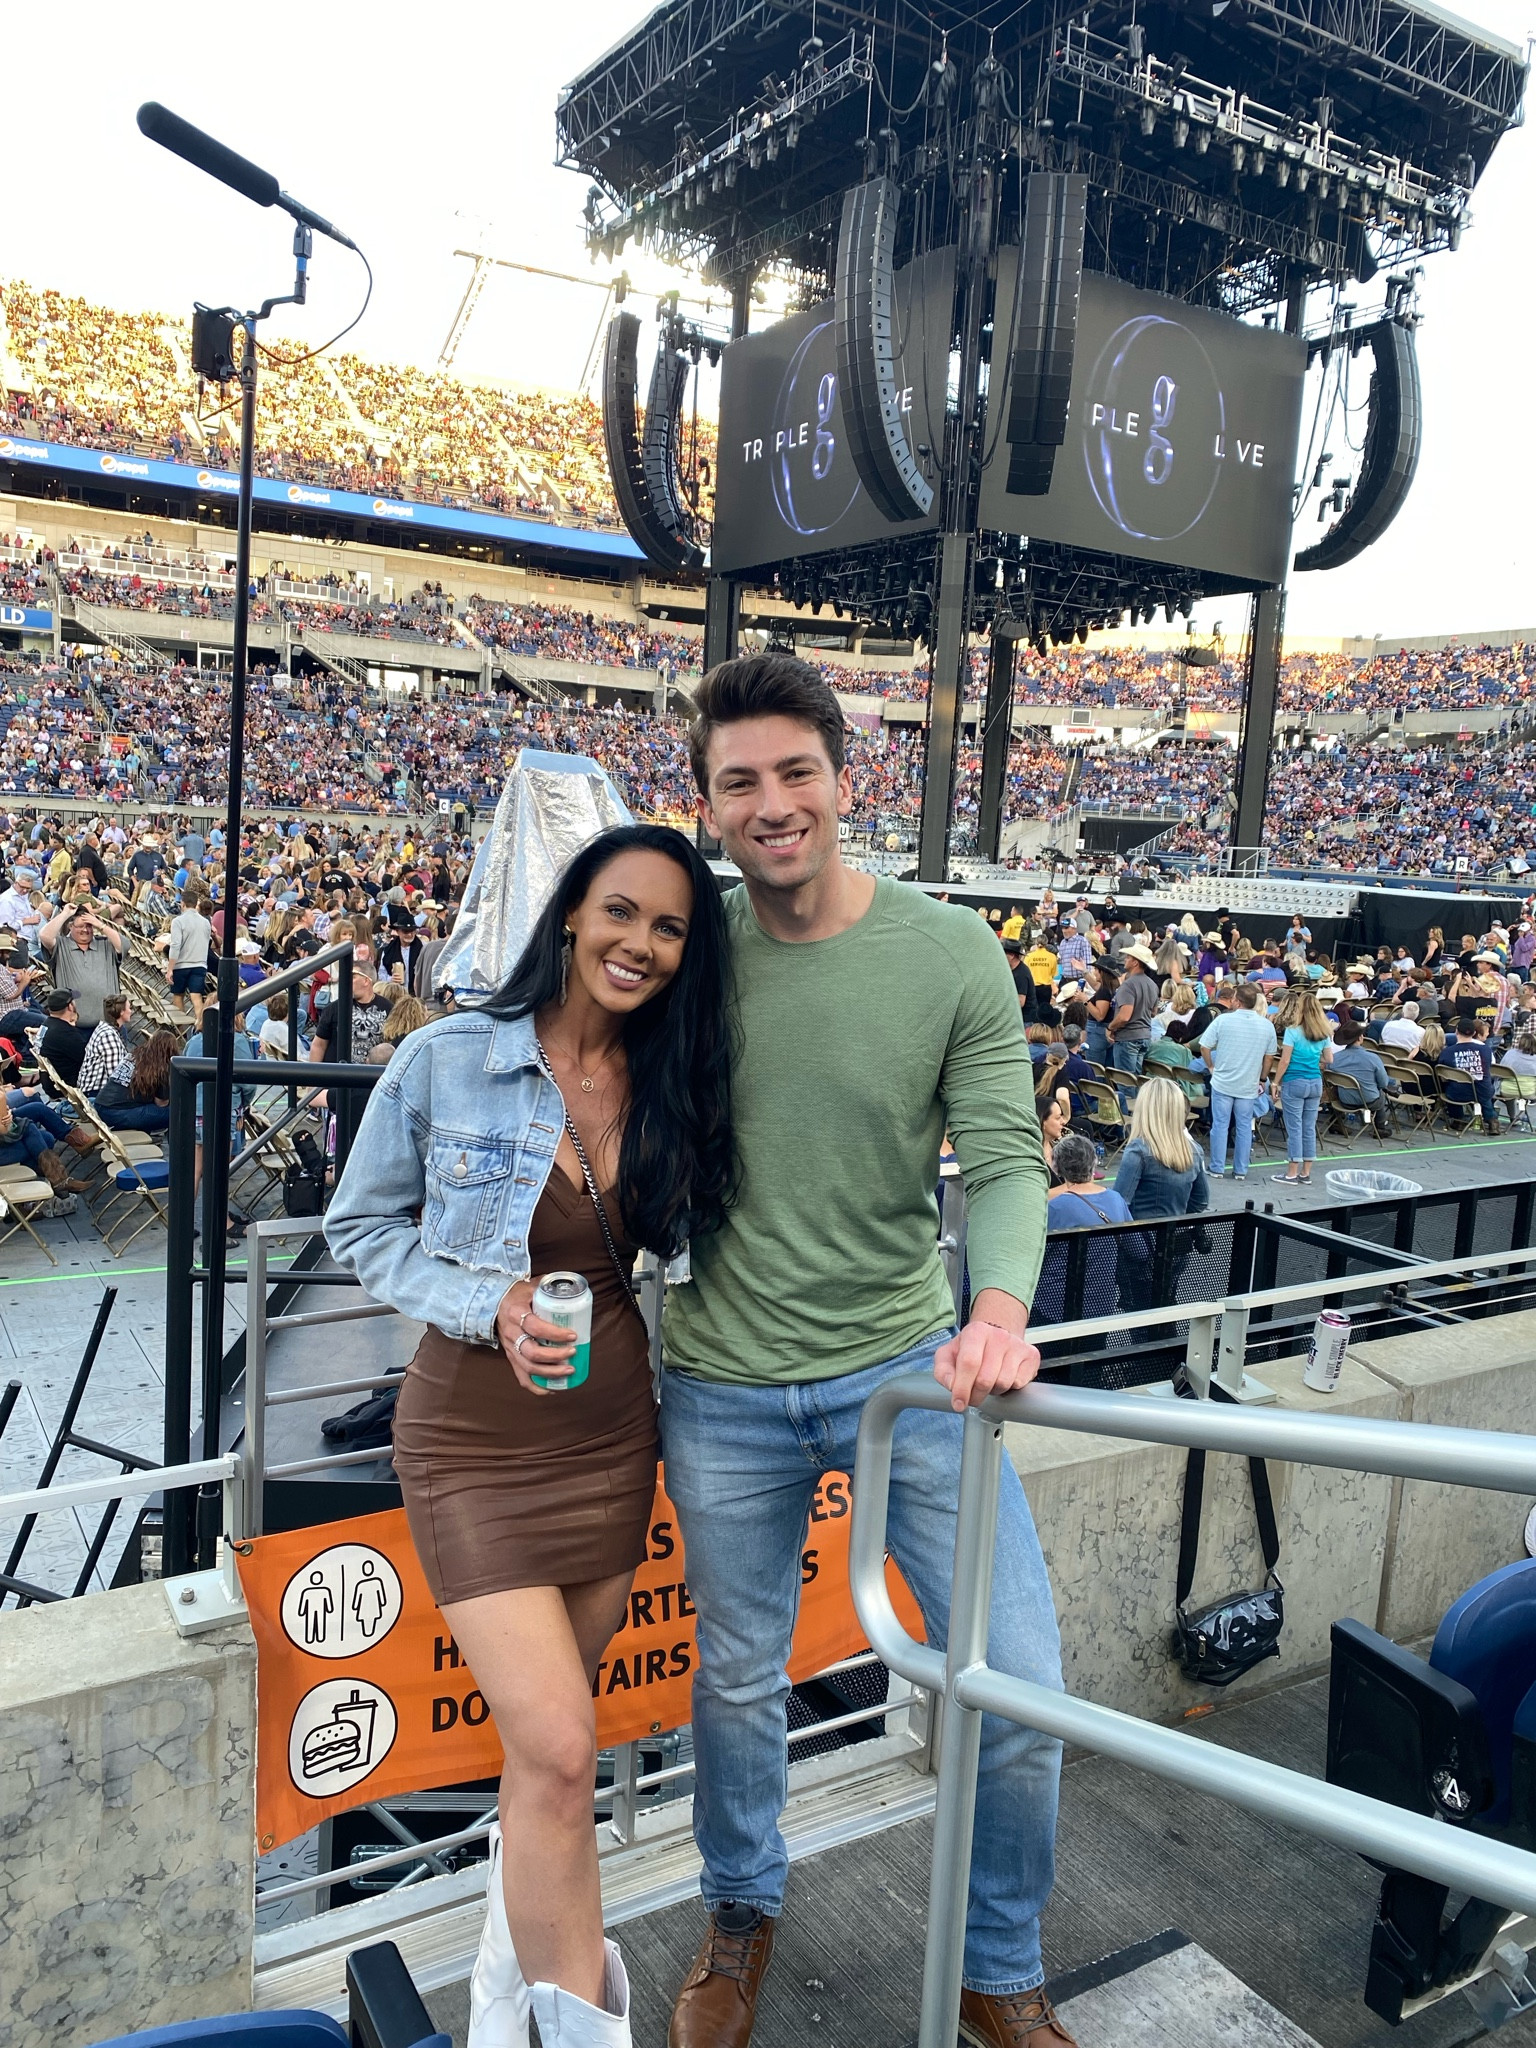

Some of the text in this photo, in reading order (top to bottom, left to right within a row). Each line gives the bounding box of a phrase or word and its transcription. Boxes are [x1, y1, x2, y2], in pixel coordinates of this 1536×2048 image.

[15, 444, 49, 459] pepsi
[117, 459, 149, 475] pepsi
[301, 490, 331, 504] pepsi
[387, 504, 414, 517] pepsi
[1455, 1055, 1482, 1063] FAITH
[1443, 1778, 1462, 1807] A
